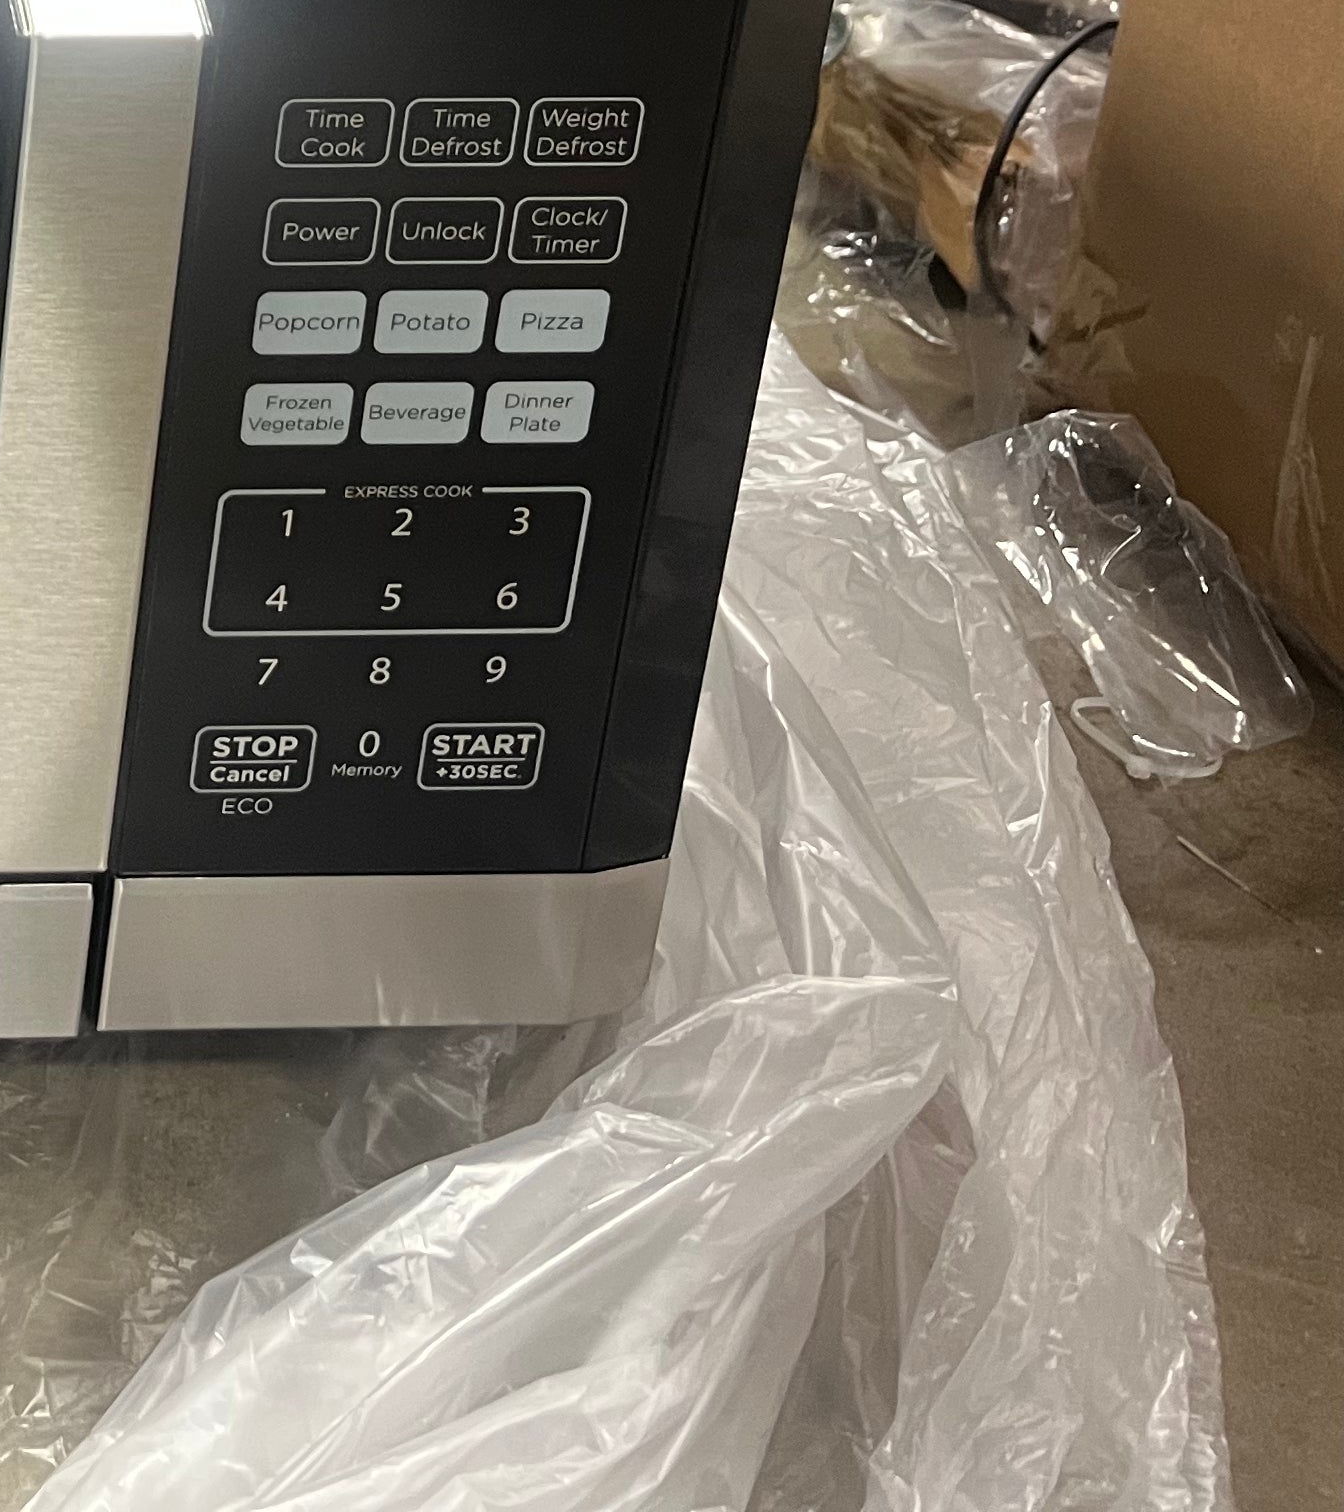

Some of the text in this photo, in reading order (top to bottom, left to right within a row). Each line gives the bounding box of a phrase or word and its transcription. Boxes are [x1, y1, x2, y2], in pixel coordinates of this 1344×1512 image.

[305, 109, 365, 129] Time
[433, 108, 491, 128] Time
[542, 107, 630, 131] Weight
[300, 137, 366, 157] Cook
[411, 136, 503, 156] Defrost
[536, 135, 628, 156] Defrost
[531, 207, 609, 227] Clock/
[282, 222, 360, 242] Power
[402, 221, 486, 241] Unlock
[531, 234, 600, 254] Timer
[258, 312, 360, 334] Popcorn
[390, 313, 471, 331] Potato
[520, 312, 584, 331] Pizza
[265, 395, 332, 410] Frozen
[504, 393, 574, 409] Dinner
[368, 404, 466, 423] Beverage
[248, 416, 345, 434] Vegetable
[509, 416, 561, 432] Plate
[344, 484, 473, 499] EXPRESS COOK
[282, 509, 294, 537] 1
[391, 508, 413, 536] 2
[508, 506, 530, 535] 3
[265, 584, 288, 612] 4
[380, 583, 403, 611] 5
[496, 582, 518, 610] 6
[258, 658, 279, 686] 7
[369, 656, 391, 685] 8
[486, 655, 507, 683] 9
[212, 735, 299, 758] STOP
[359, 730, 381, 758] 0
[431, 733, 537, 758] START
[210, 764, 290, 783] Cancel
[331, 763, 403, 779] Memory
[221, 797, 273, 815] ECO
